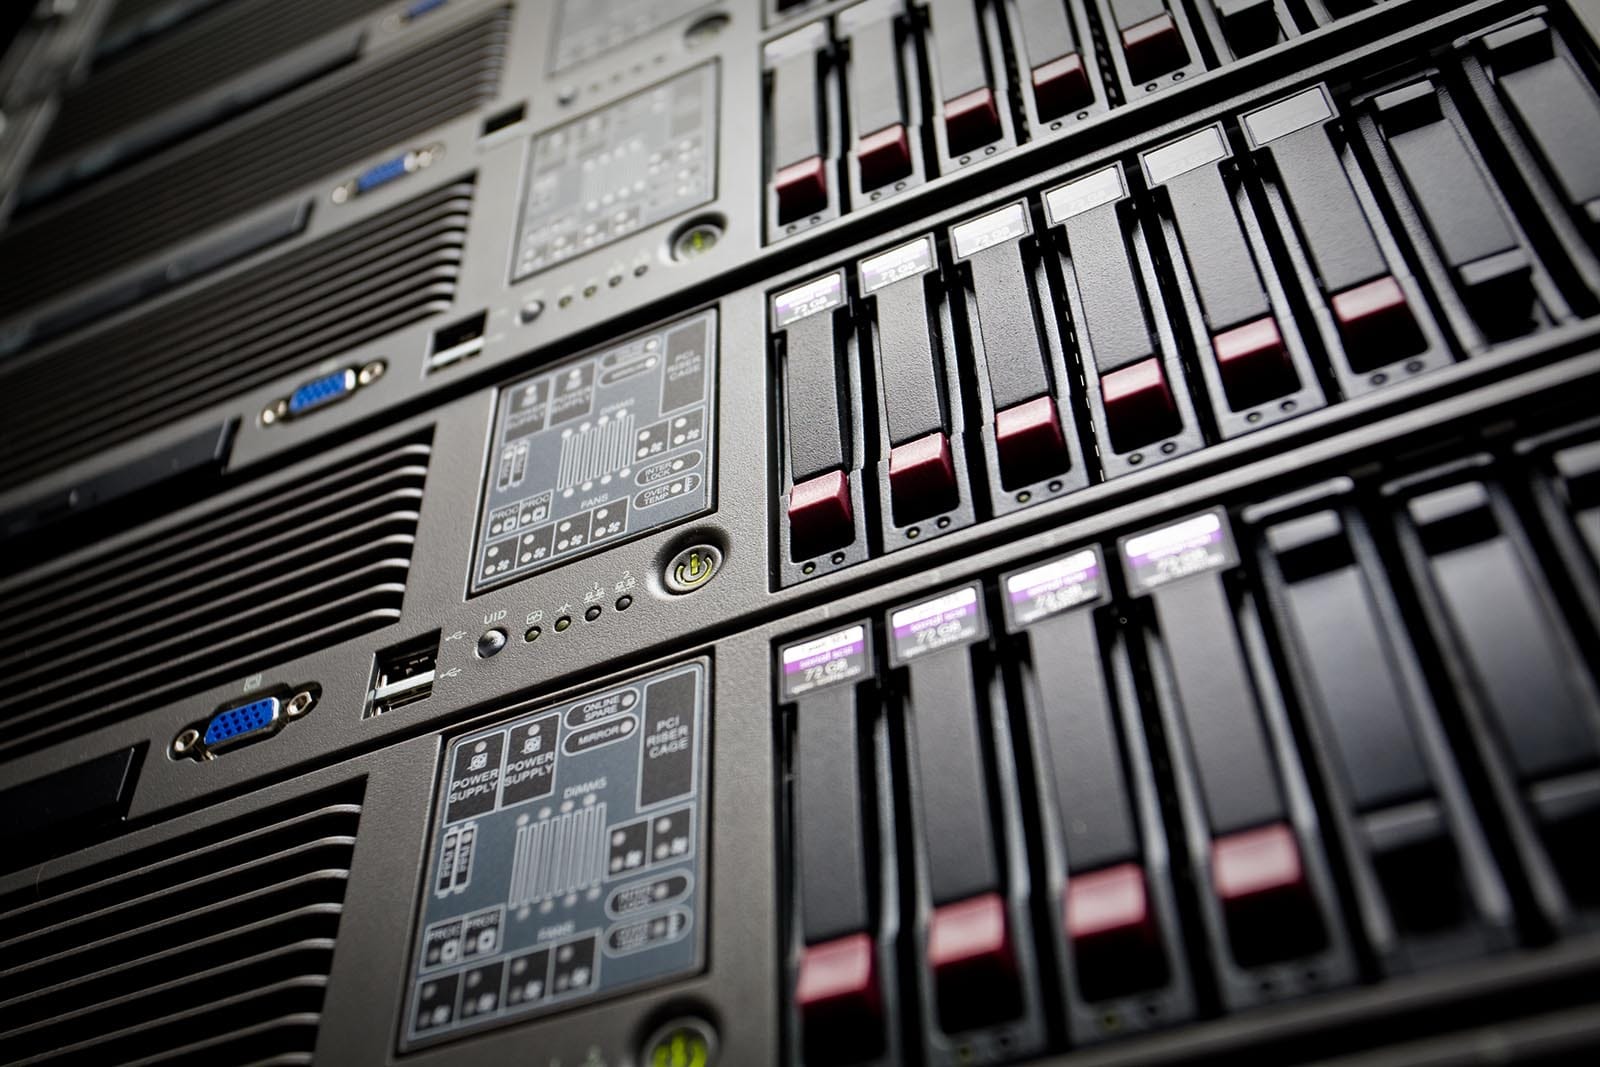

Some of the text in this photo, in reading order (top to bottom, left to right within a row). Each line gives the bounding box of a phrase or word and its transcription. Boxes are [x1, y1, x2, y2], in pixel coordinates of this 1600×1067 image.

[645, 462, 672, 476] INTER
[646, 471, 670, 482] LOCK
[644, 485, 670, 498] OVER
[644, 492, 669, 504] TEMP
[521, 494, 550, 509] PROC
[581, 494, 608, 510] FANS
[491, 506, 519, 520] PROC
[483, 610, 507, 624] UID
[804, 665, 824, 682] 72
[824, 658, 849, 676] GB
[583, 695, 620, 713] ONLINE
[584, 705, 618, 722] SPARE
[657, 714, 680, 732] PCI
[578, 725, 620, 745] MIRROR
[646, 725, 689, 747] RISER
[649, 737, 689, 759] CAGE
[507, 751, 554, 773] POWER
[452, 768, 498, 791] POWER
[504, 763, 554, 787] SUPPLY
[450, 780, 498, 803] SUPPLY
[563, 777, 607, 799] DIMMS
